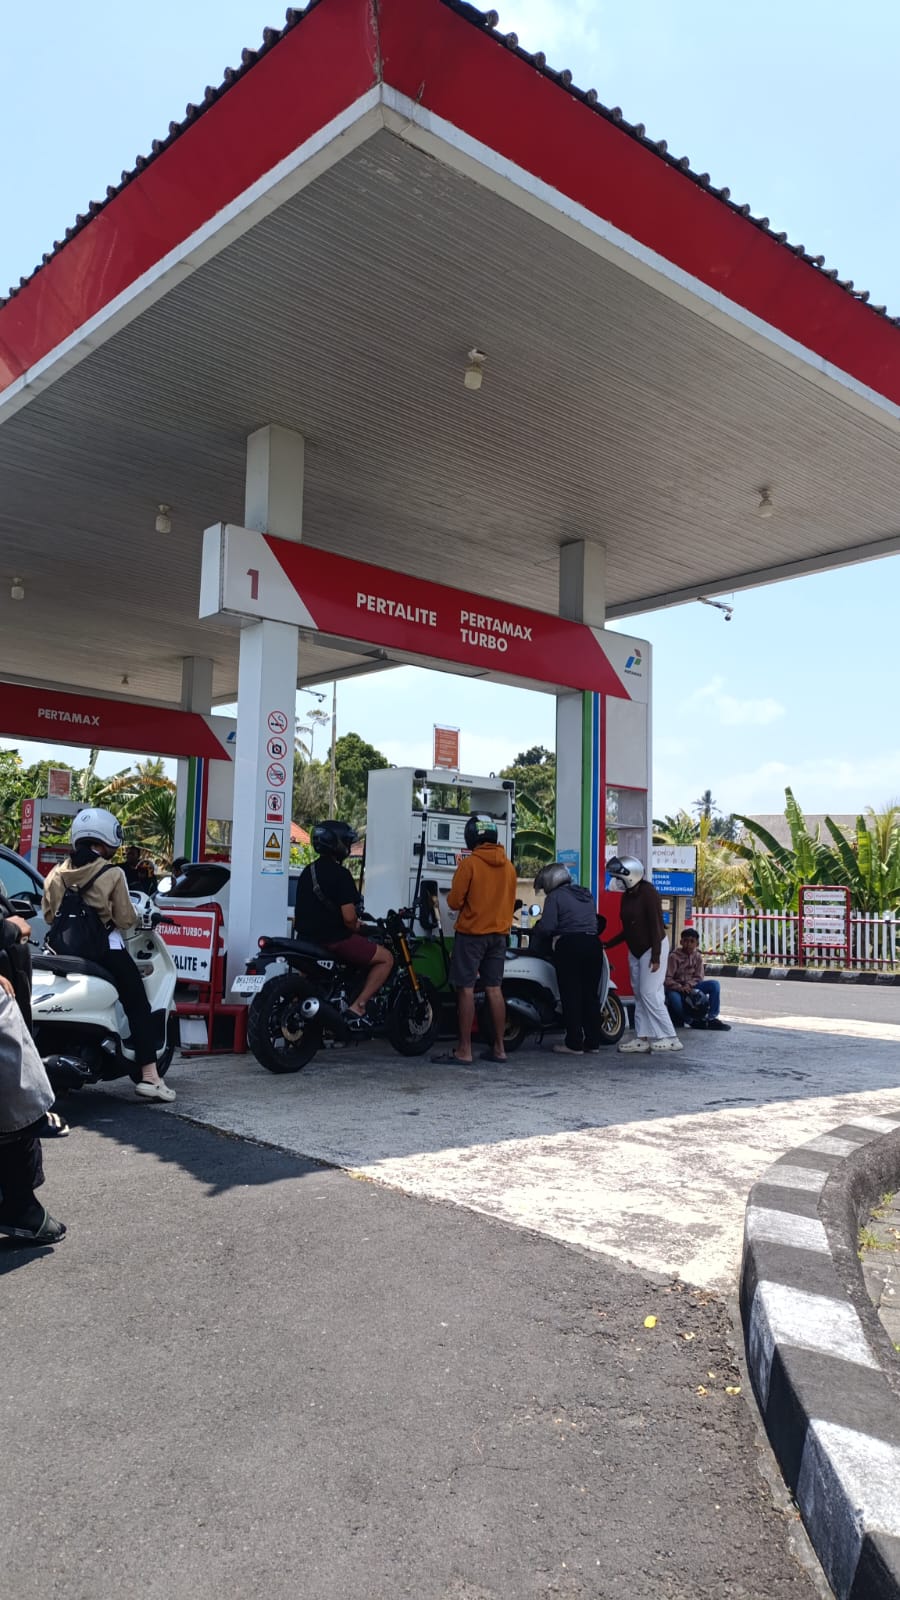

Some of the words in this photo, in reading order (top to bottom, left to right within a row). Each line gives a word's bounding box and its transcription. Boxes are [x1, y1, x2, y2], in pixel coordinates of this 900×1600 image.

[246, 568, 260, 600] 1
[356, 592, 438, 628] PERTALITE
[460, 610, 533, 642] PERTAMAX
[460, 628, 508, 653] TURBO
[37, 707, 101, 727] PERTAMAX
[154, 924, 181, 935] ERTAMAX
[182, 926, 203, 938] TURBO
[172, 955, 198, 971] ALITE
